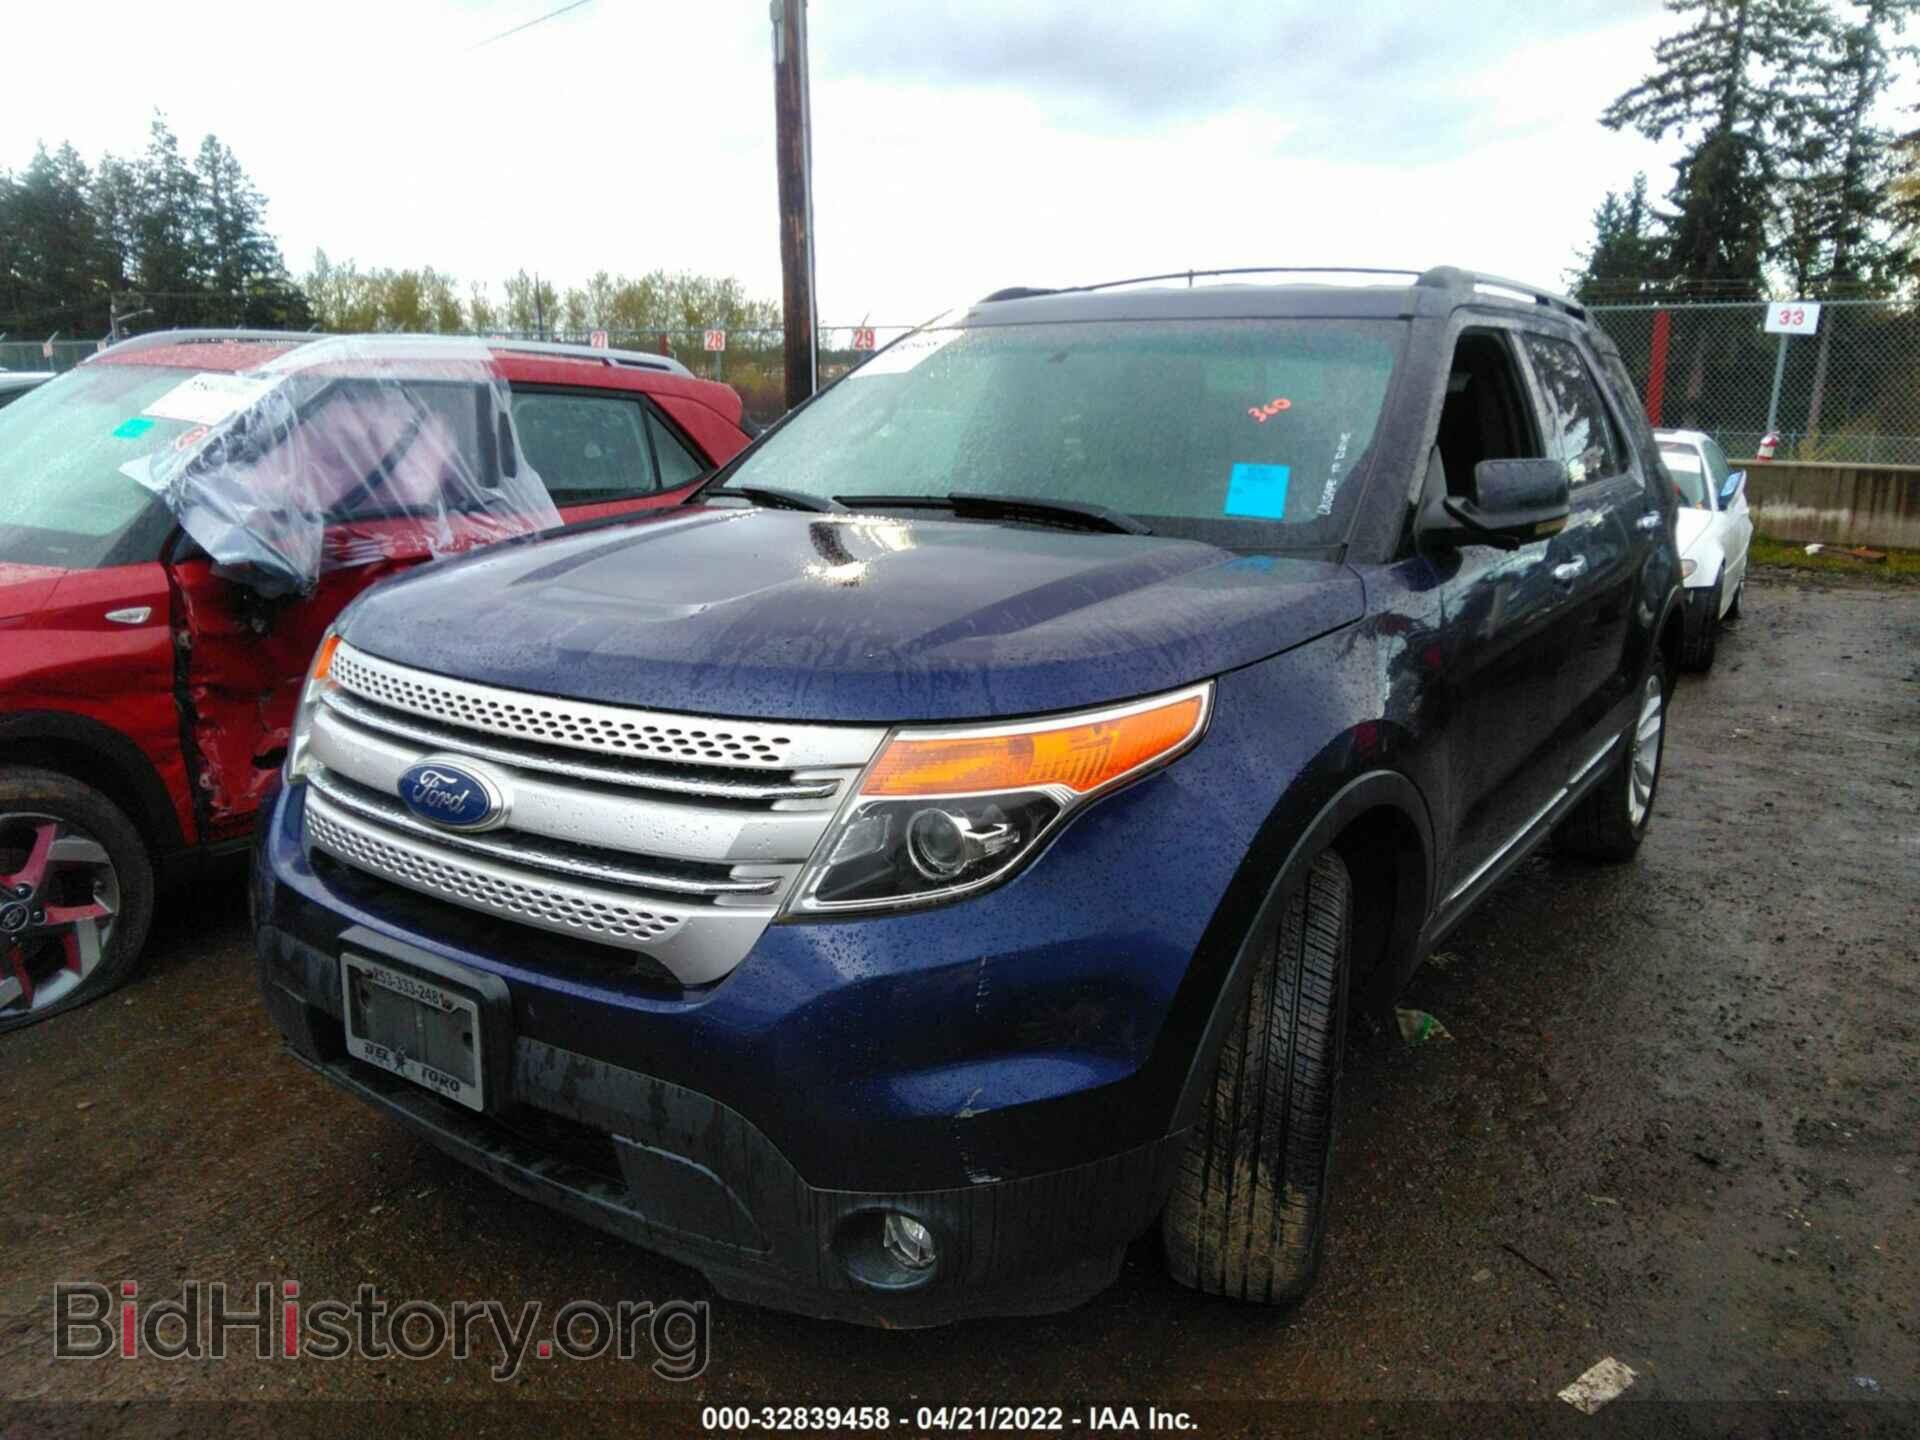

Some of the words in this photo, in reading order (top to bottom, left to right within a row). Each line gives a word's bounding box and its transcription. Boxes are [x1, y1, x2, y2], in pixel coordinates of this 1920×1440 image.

[1778, 309, 1805, 326] 33
[705, 331, 723, 350] 28
[853, 329, 875, 349] 29
[412, 769, 471, 814] Ford
